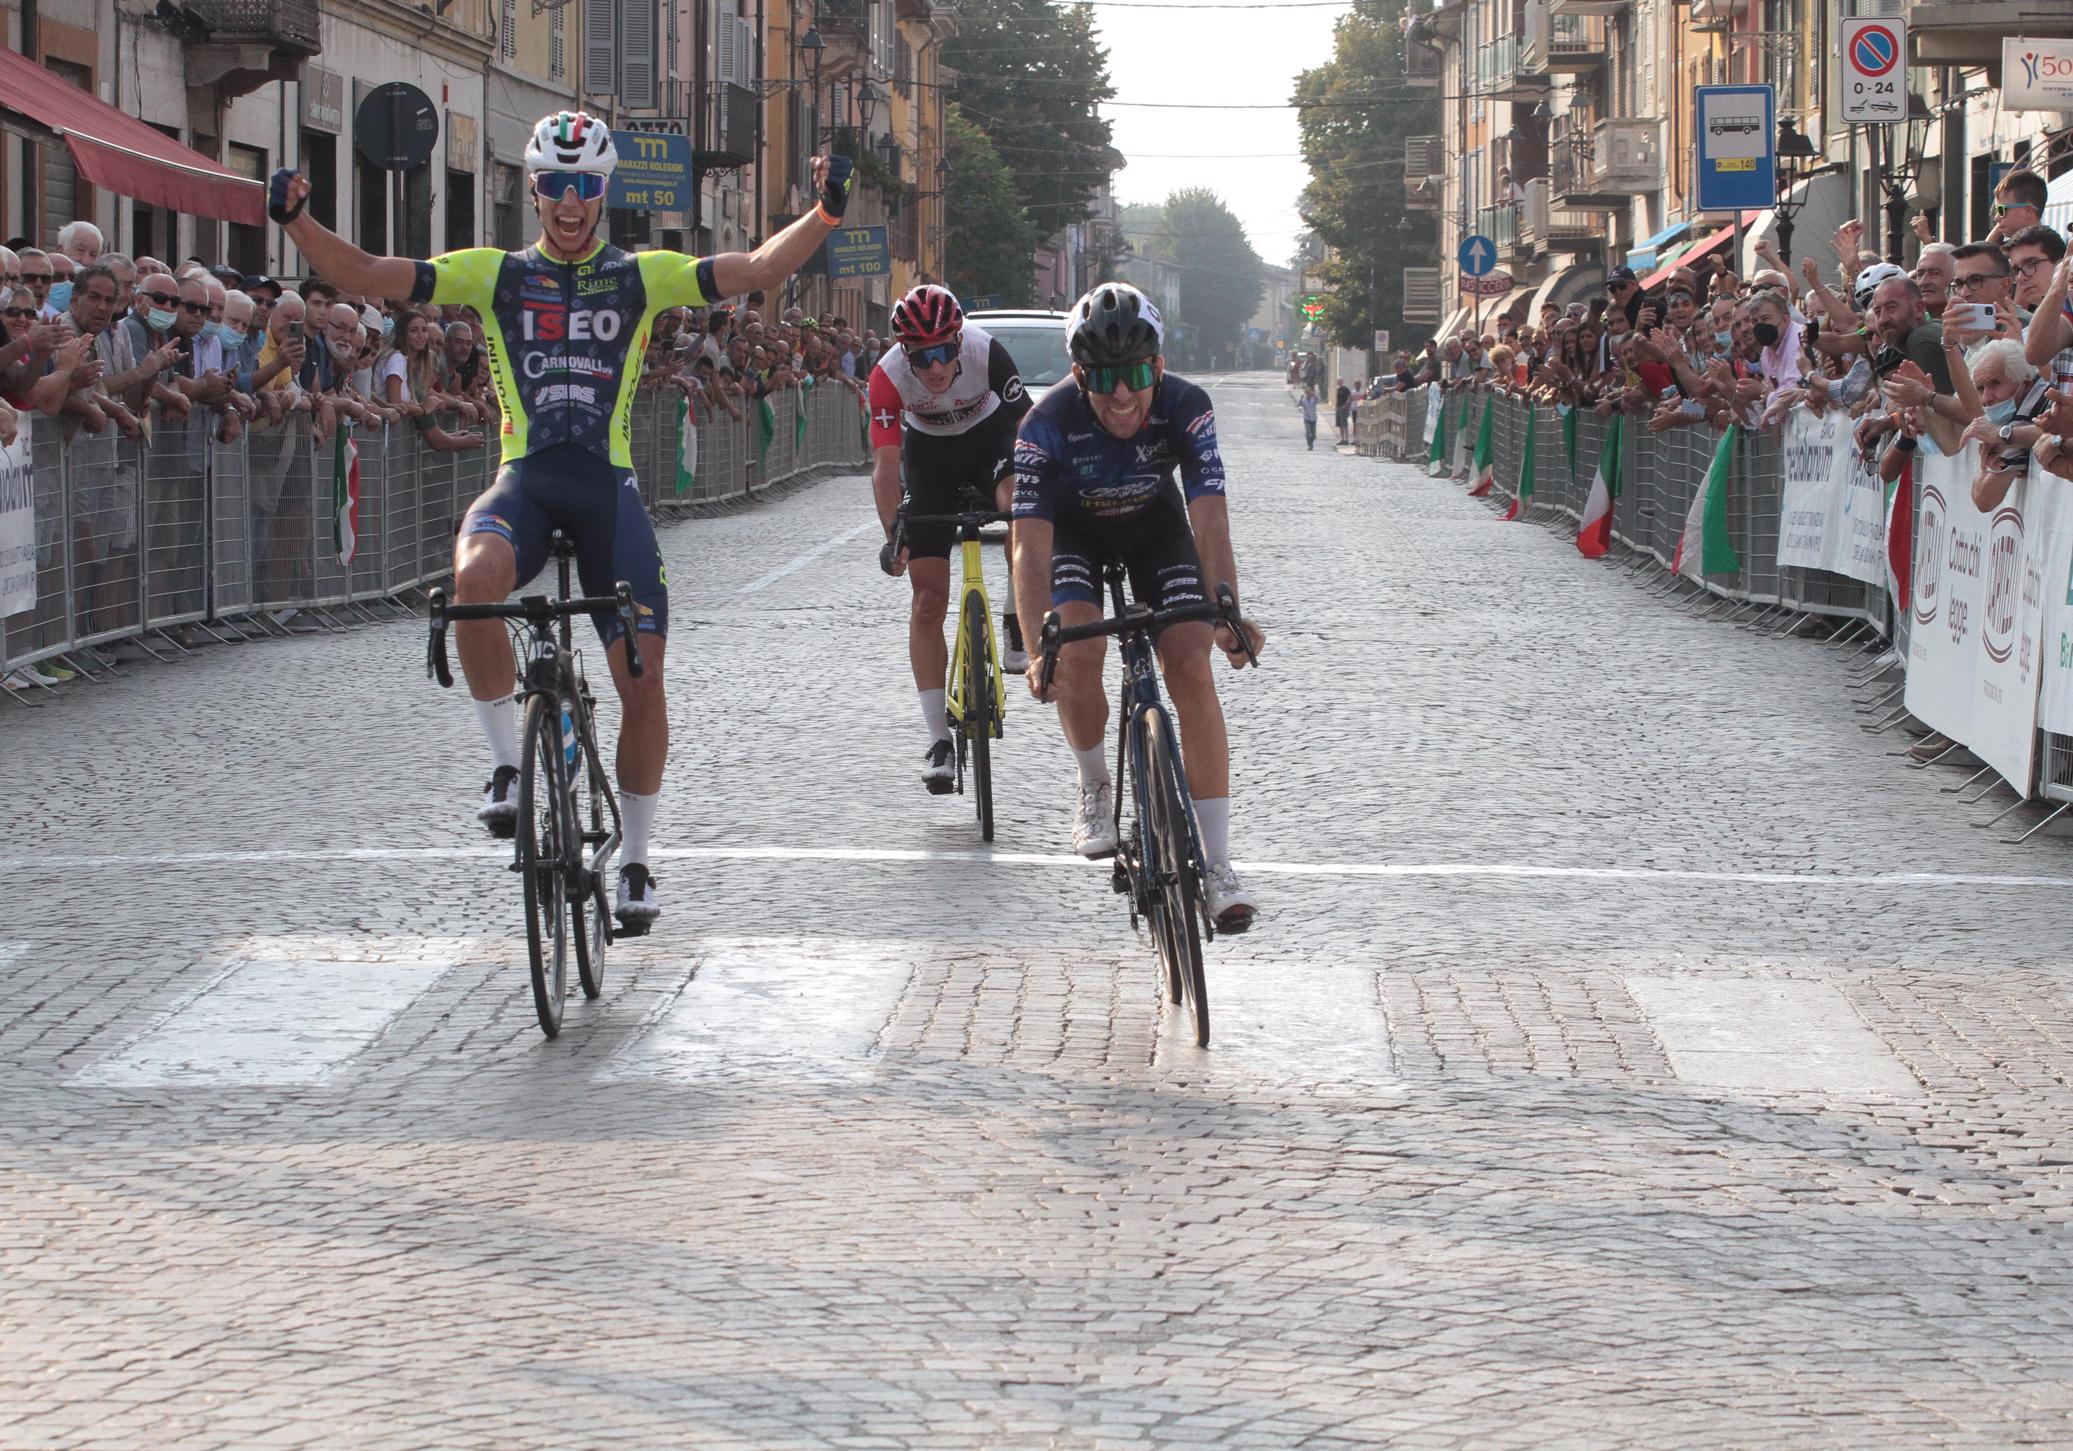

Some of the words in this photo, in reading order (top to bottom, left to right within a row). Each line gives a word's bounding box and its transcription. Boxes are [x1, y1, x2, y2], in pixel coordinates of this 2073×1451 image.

[1739, 158, 1755, 170] 140
[626, 191, 648, 204] mt
[654, 191, 675, 206] 50
[839, 264, 856, 275] mt
[859, 262, 881, 273] 100
[523, 309, 621, 342] ISEO
[523, 350, 602, 379] CARNOVALI
[1949, 526, 1969, 575] Cotto
[1968, 531, 1982, 579] chi
[1948, 583, 1968, 645] legge.
